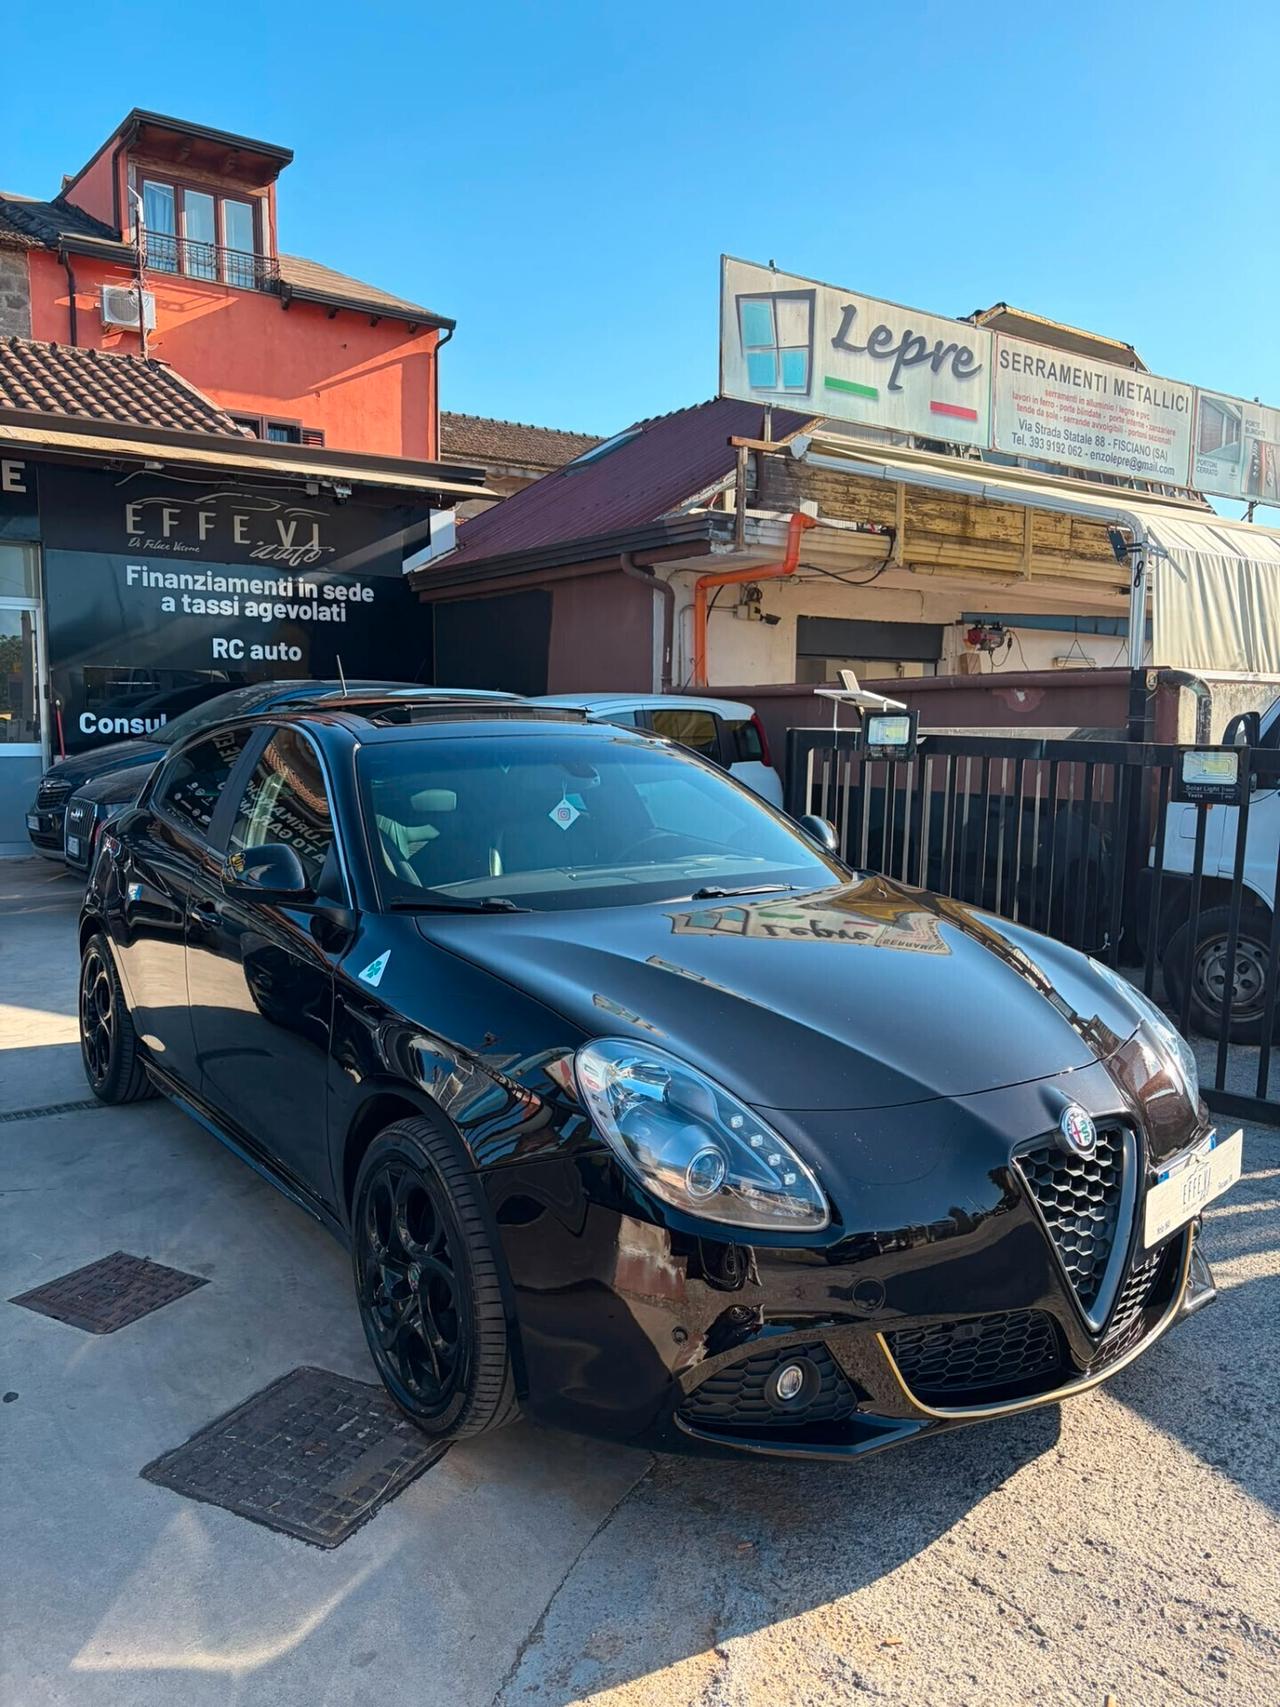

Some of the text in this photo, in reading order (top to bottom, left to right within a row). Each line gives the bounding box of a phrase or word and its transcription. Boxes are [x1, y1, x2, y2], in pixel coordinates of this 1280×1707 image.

[831, 304, 983, 390] Lepre
[1000, 349, 1189, 414] SERRAMENTI METALLICI
[1011, 431, 1027, 446] Tel.
[1029, 436, 1045, 449] 393
[1046, 439, 1066, 453] 9192
[1067, 444, 1083, 458] 062
[1090, 450, 1175, 476] enzolepre@gmail.com
[1018, 418, 1033, 432] Via
[1034, 421, 1062, 438] Strada
[1063, 429, 1093, 445] Statale
[1094, 435, 1106, 448] 88
[1113, 438, 1151, 457] FISCIANO
[1152, 446, 1168, 463] (SA)
[126, 565, 375, 602] Finanziamenti in sede
[161, 593, 346, 623] a tassi agevolati
[212, 638, 302, 662] RC auto
